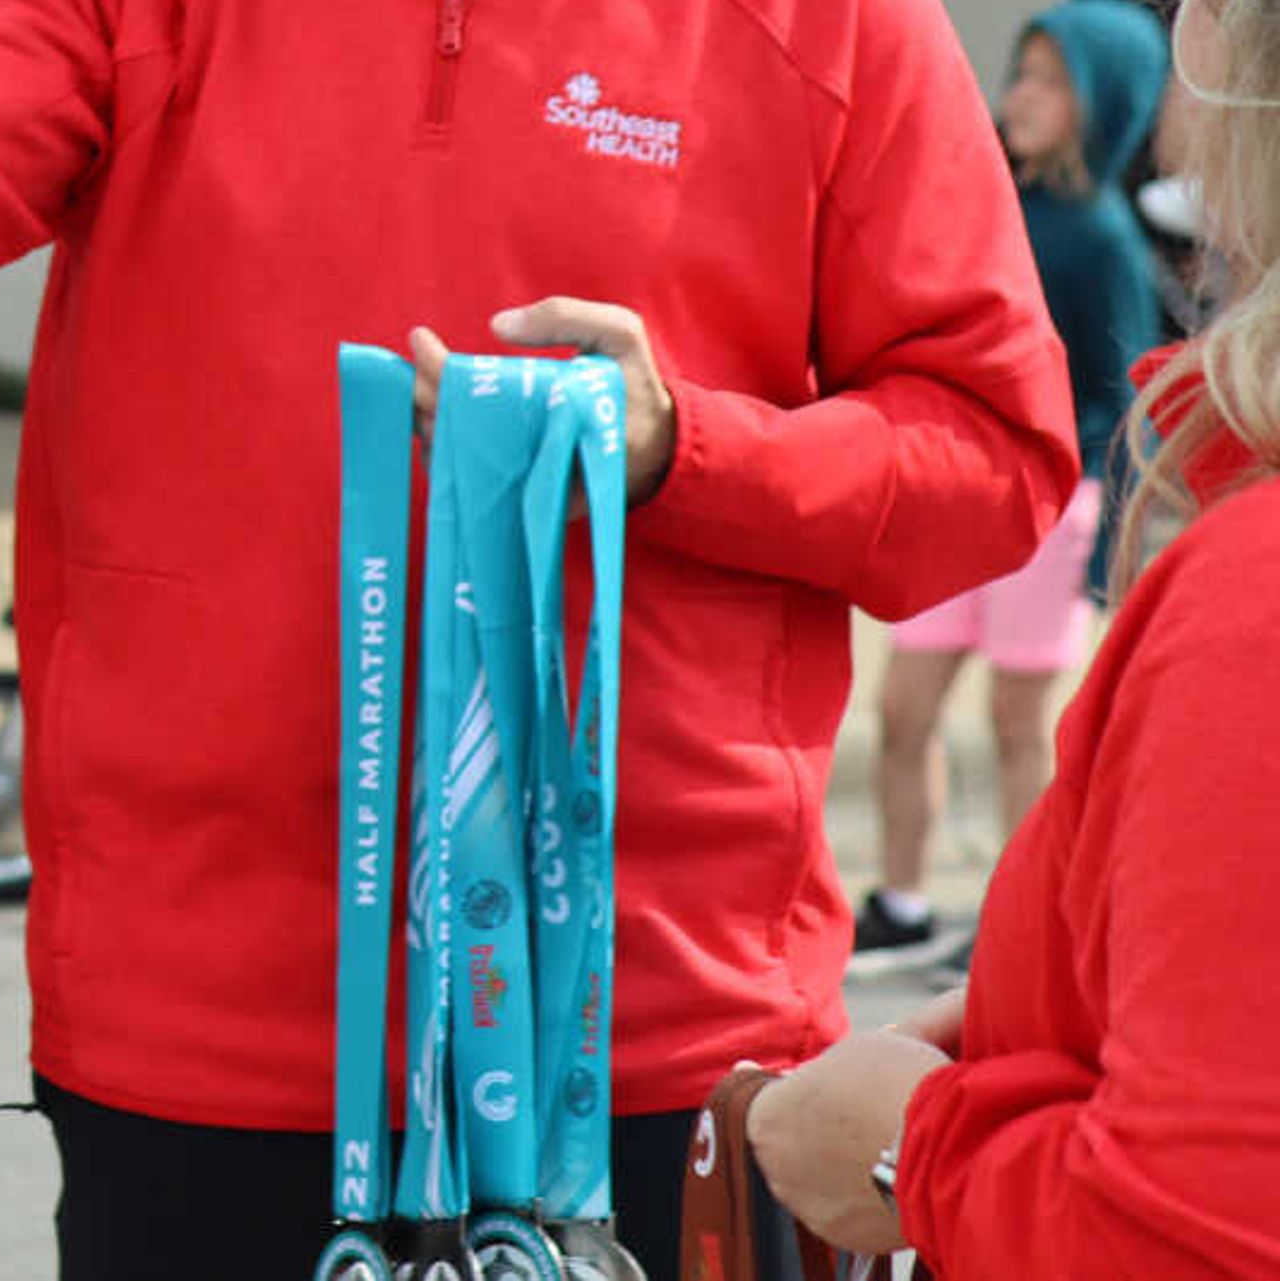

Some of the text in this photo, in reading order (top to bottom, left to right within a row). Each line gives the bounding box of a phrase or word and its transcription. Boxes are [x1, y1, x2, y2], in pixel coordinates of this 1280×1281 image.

[545, 95, 681, 144] Southeast
[585, 132, 680, 168] HEALTH
[355, 557, 389, 905] HALF MARATHON
